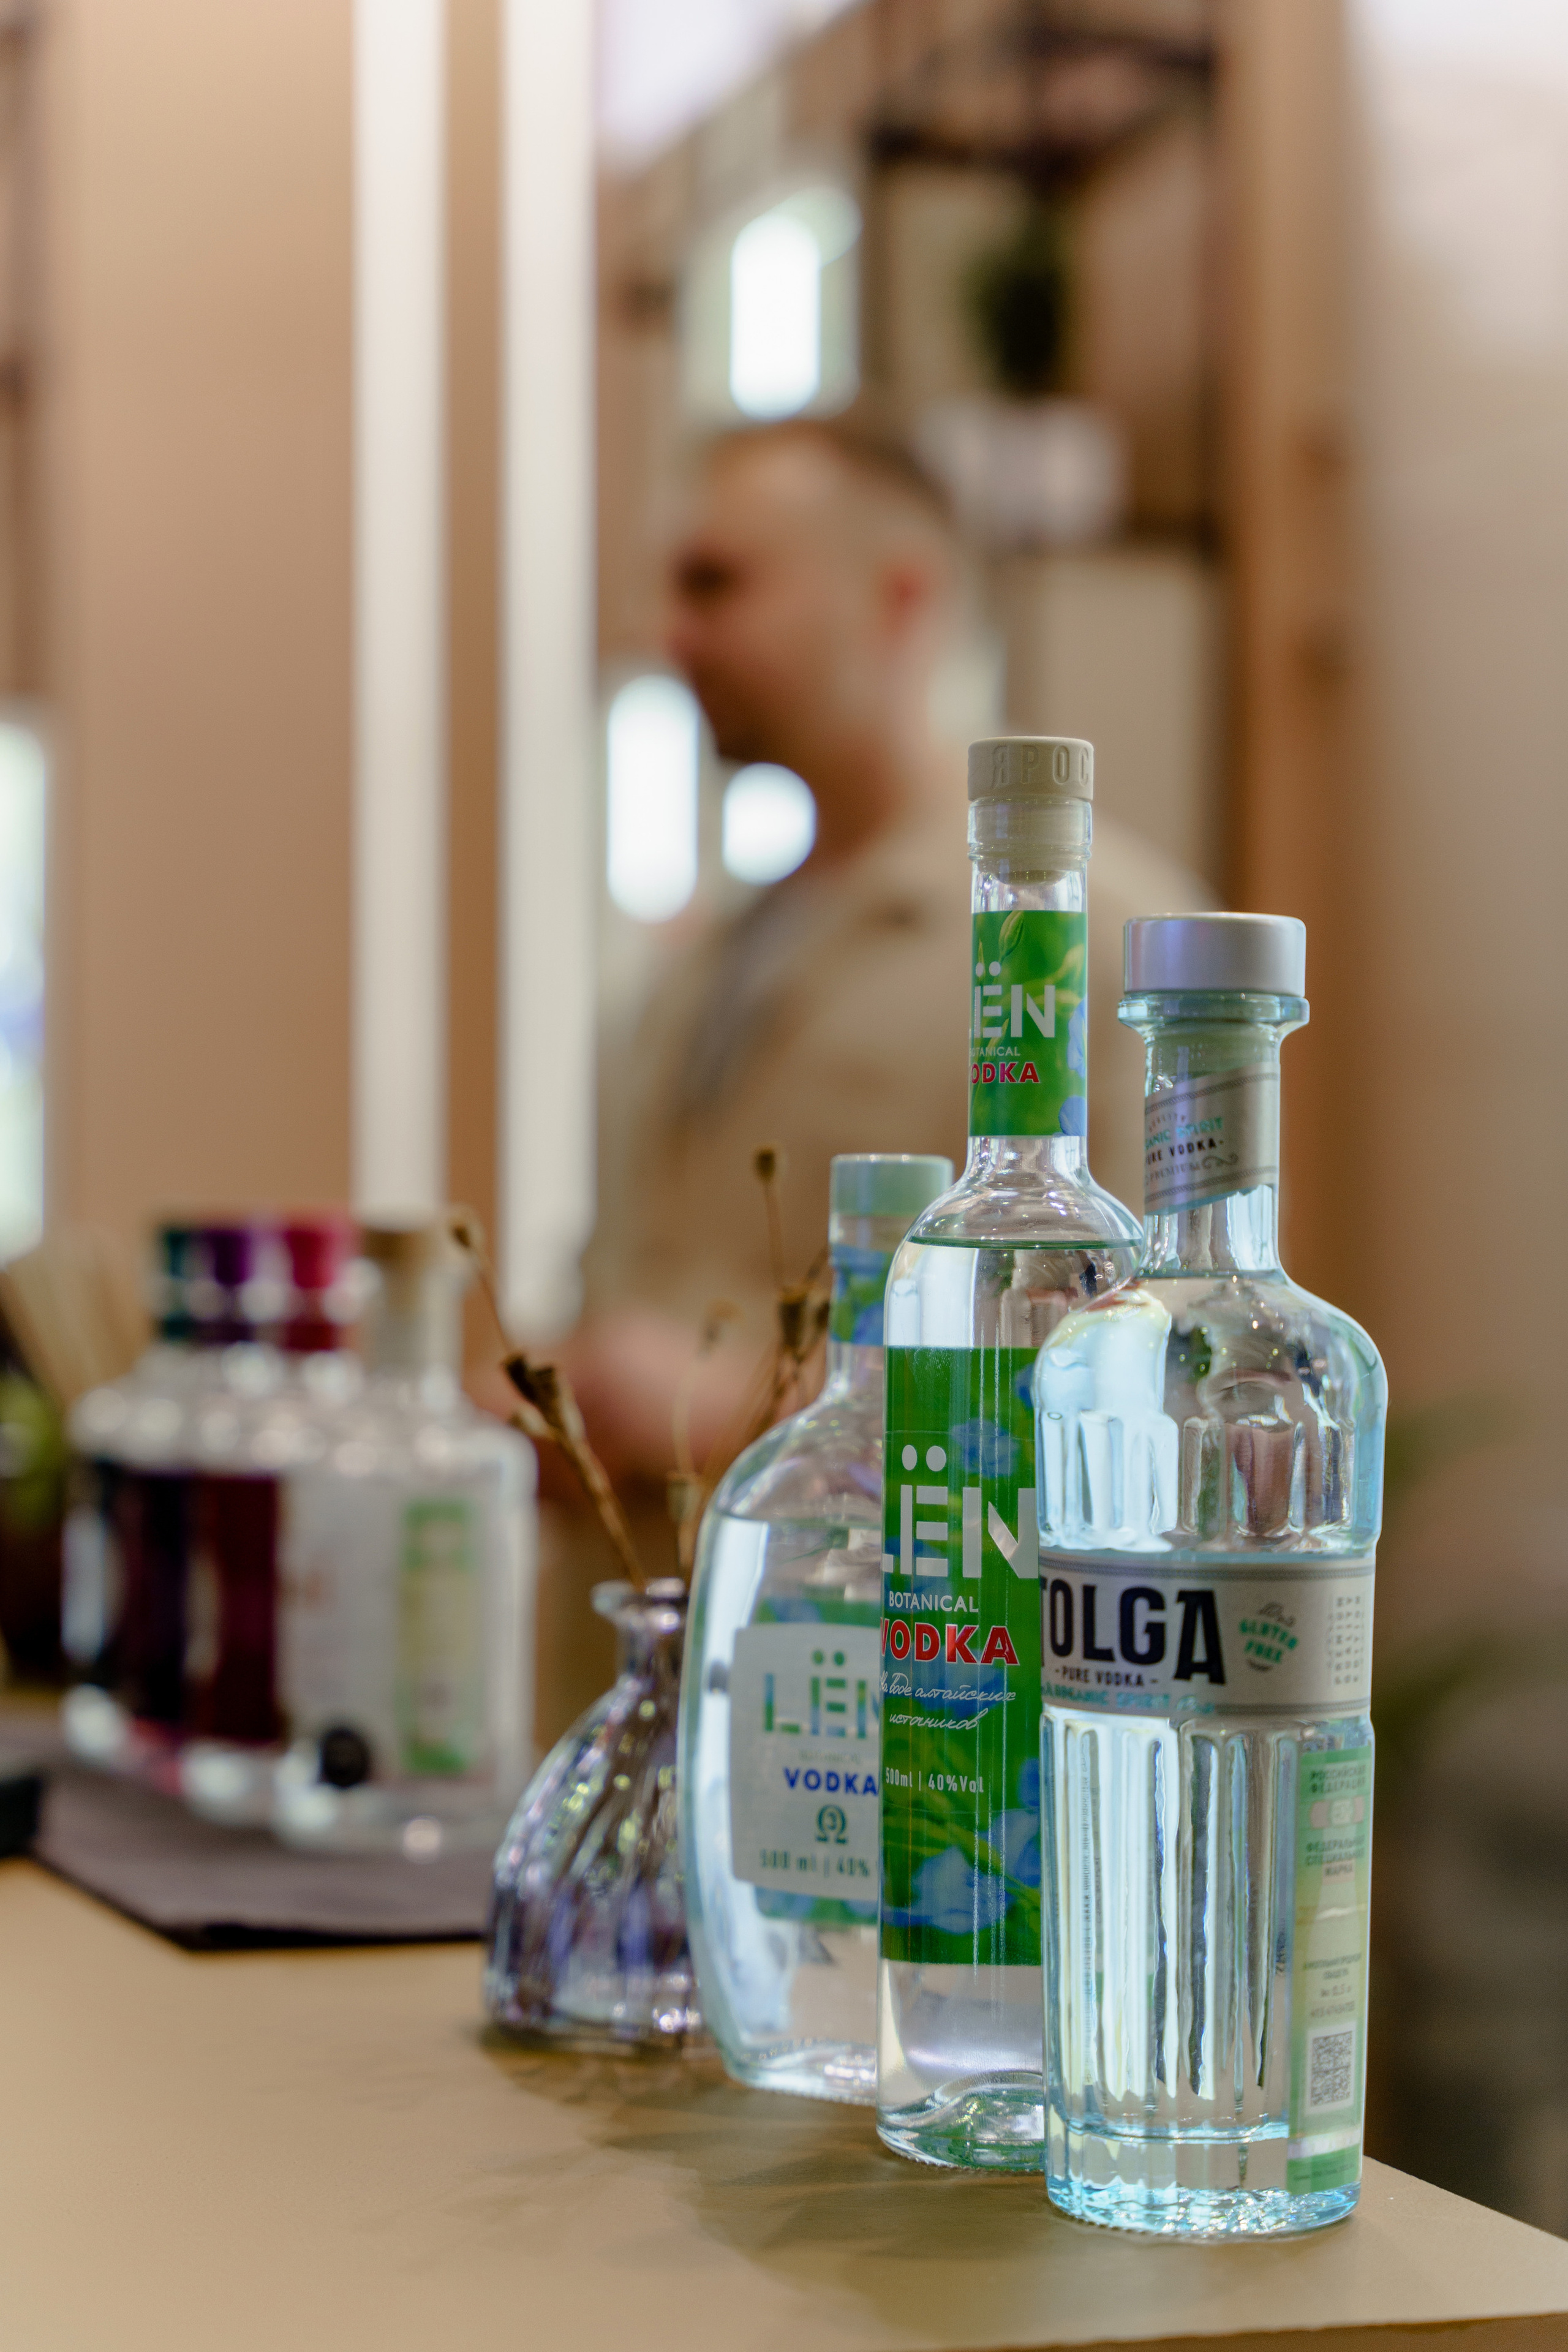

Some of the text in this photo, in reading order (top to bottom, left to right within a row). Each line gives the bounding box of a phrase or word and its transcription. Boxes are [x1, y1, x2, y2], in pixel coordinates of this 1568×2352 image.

[973, 961, 1055, 1038] ËN
[971, 1061, 1041, 1084] ODKA
[1169, 1137, 1216, 1157] VODKA
[881, 1444, 1039, 1579] ËN
[889, 1591, 979, 1613] BOTANICAL
[880, 1617, 1020, 1666] VODKA
[1095, 1670, 1145, 1687] VODKA
[782, 1765, 879, 1797] VODKA
[886, 1766, 913, 1788] 500ml
